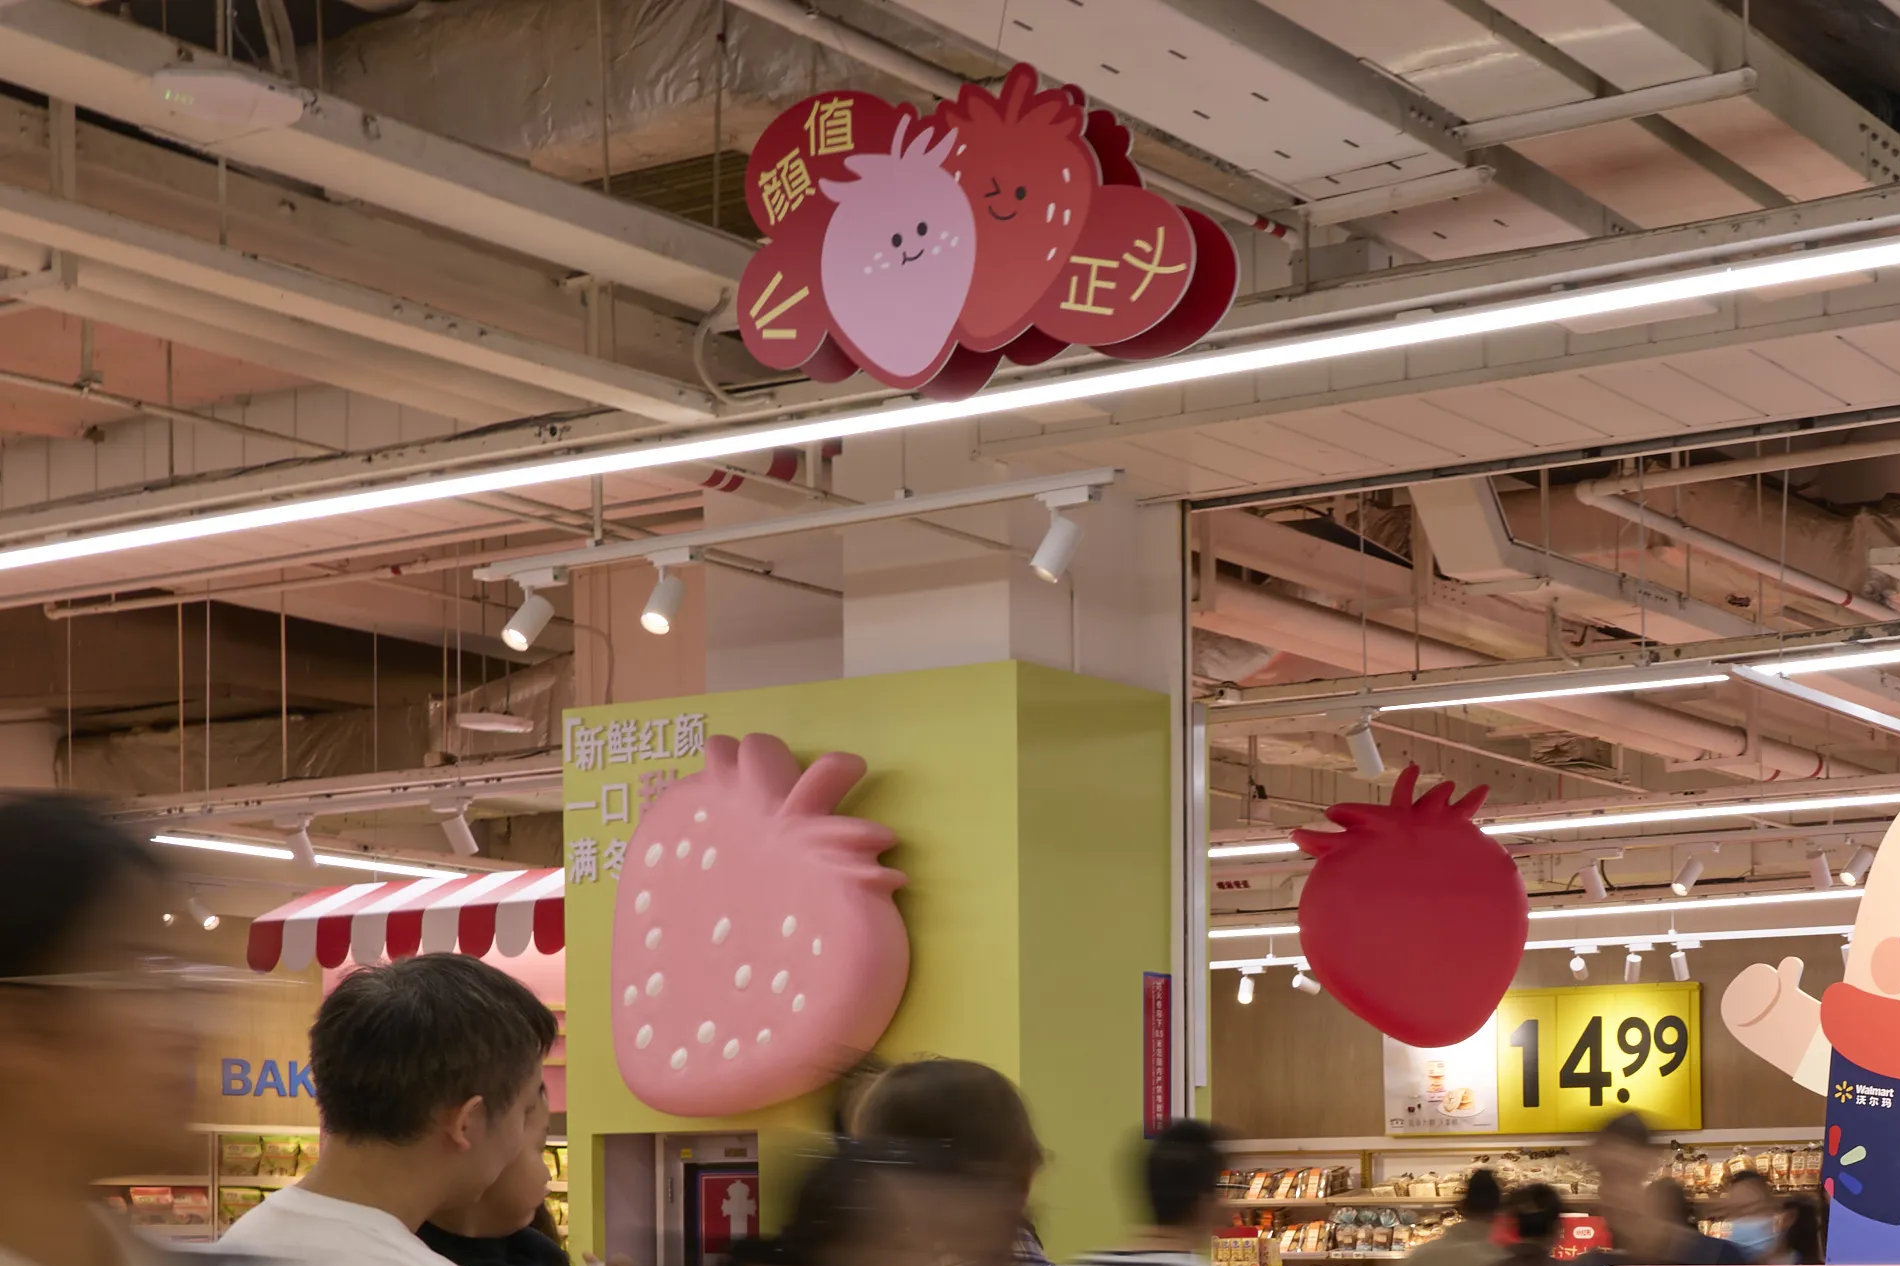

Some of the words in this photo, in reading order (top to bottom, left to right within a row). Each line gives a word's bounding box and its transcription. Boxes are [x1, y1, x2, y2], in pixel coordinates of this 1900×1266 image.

[1060, 226, 1187, 316] 正义
[1511, 1015, 1688, 1108] 14.99
[1855, 1084, 1894, 1098] Walmart
[1855, 1095, 1892, 1109] 沃尔玛
